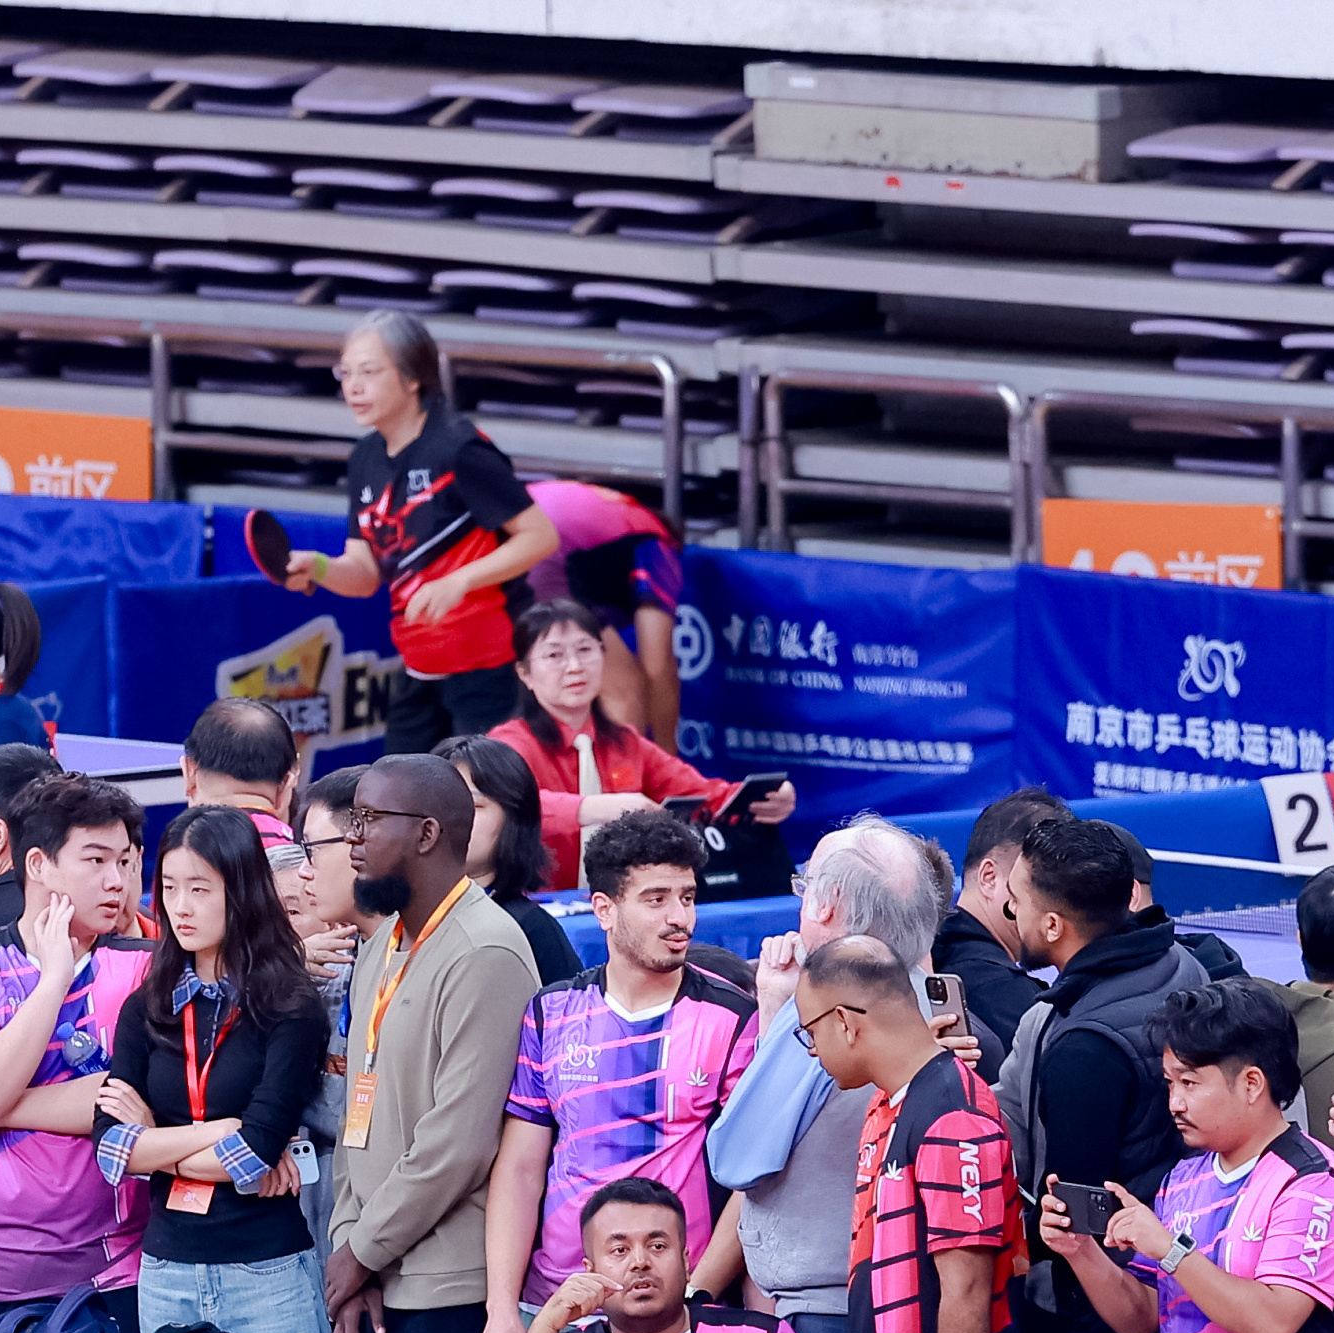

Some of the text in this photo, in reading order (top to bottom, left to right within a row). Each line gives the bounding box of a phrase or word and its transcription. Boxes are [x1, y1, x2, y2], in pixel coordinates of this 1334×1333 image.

[1286, 792, 1329, 854] 2
[958, 1141, 984, 1225] NEXY
[1298, 1194, 1334, 1278] NEXY
